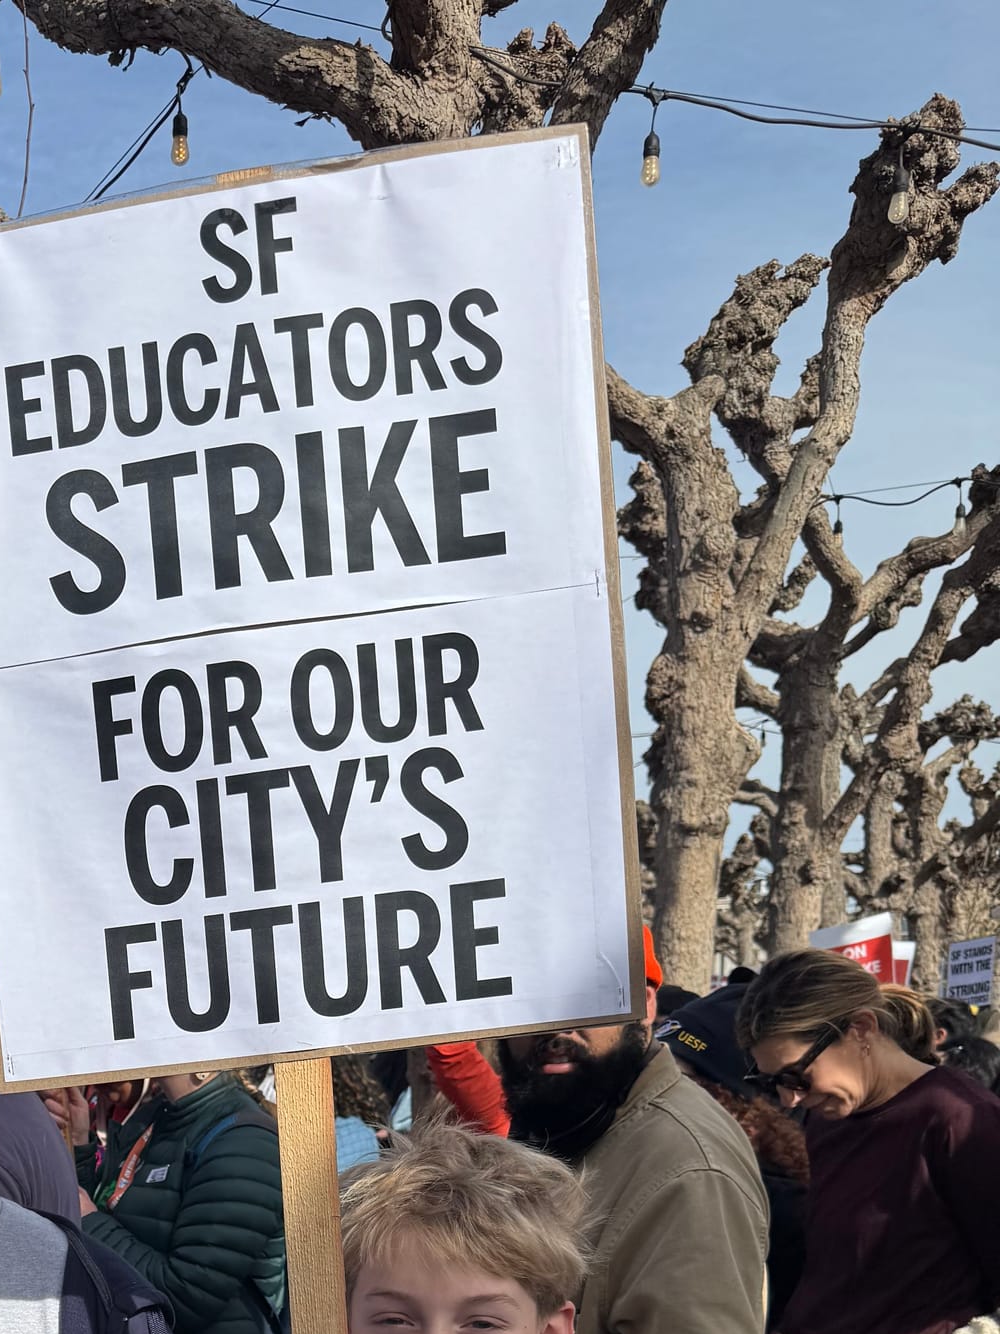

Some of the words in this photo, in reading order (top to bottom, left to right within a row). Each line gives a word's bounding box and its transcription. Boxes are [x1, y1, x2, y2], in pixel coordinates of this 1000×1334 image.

[200, 197, 297, 304] SF
[4, 288, 503, 457] EDUCATORS
[45, 407, 507, 615] STRIKE
[91, 660, 269, 783] FOR
[290, 632, 485, 752] OUR
[124, 746, 469, 906] CITY'S
[104, 877, 513, 1041] FUTURE
[842, 944, 868, 959] ON
[949, 980, 990, 998] STRIKING
[951, 950, 961, 961] SF
[963, 944, 992, 959] STANDS
[951, 961, 973, 975] WITH
[976, 958, 991, 972] THE
[678, 1031, 708, 1052] UESF
